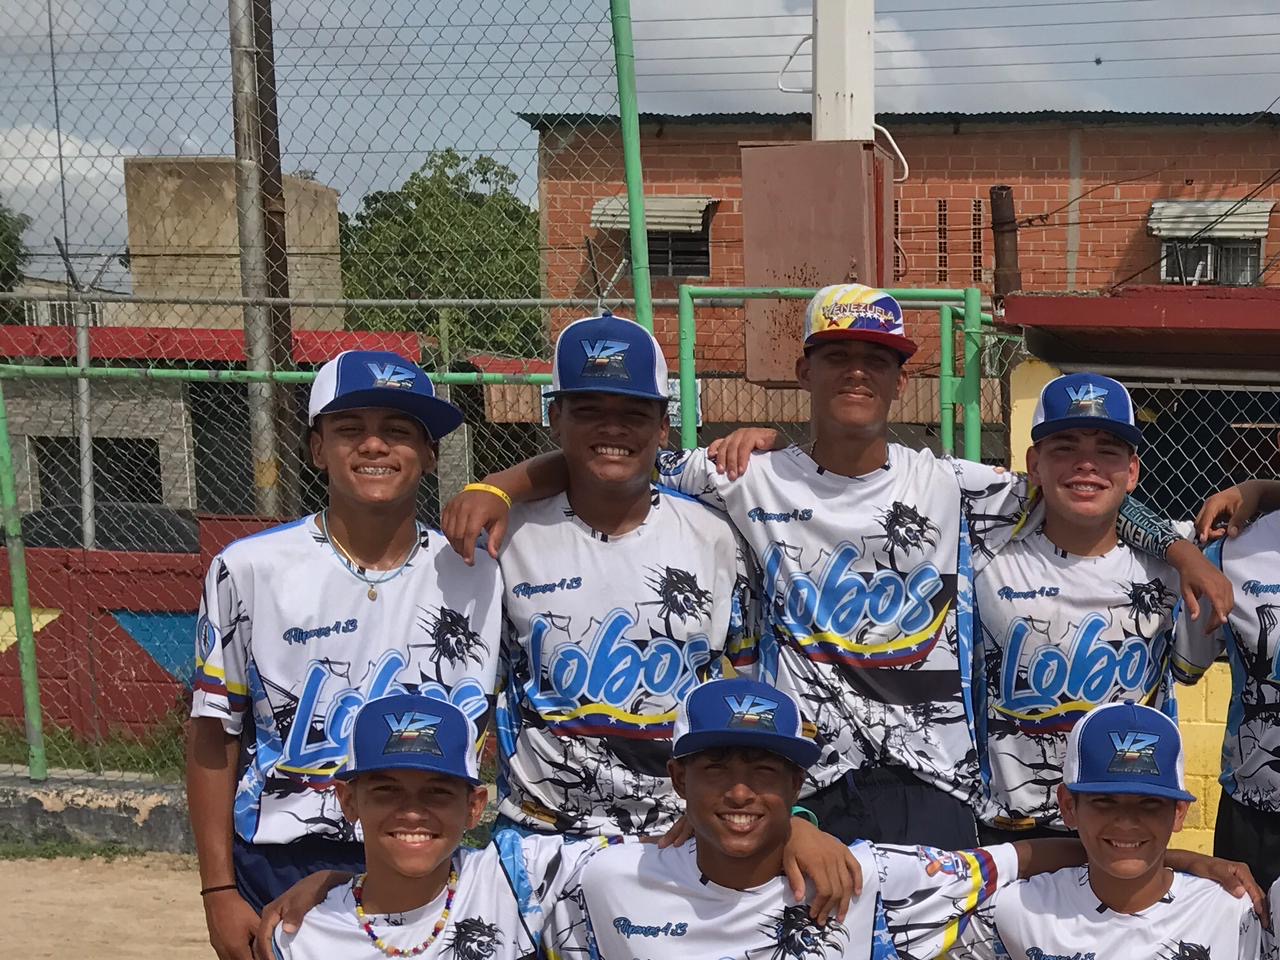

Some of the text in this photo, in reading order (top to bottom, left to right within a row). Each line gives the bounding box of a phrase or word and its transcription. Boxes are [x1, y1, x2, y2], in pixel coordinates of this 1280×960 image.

[822, 302, 896, 324] VENEZUELA
[761, 540, 944, 640] Lobos
[523, 607, 711, 711] Lobos
